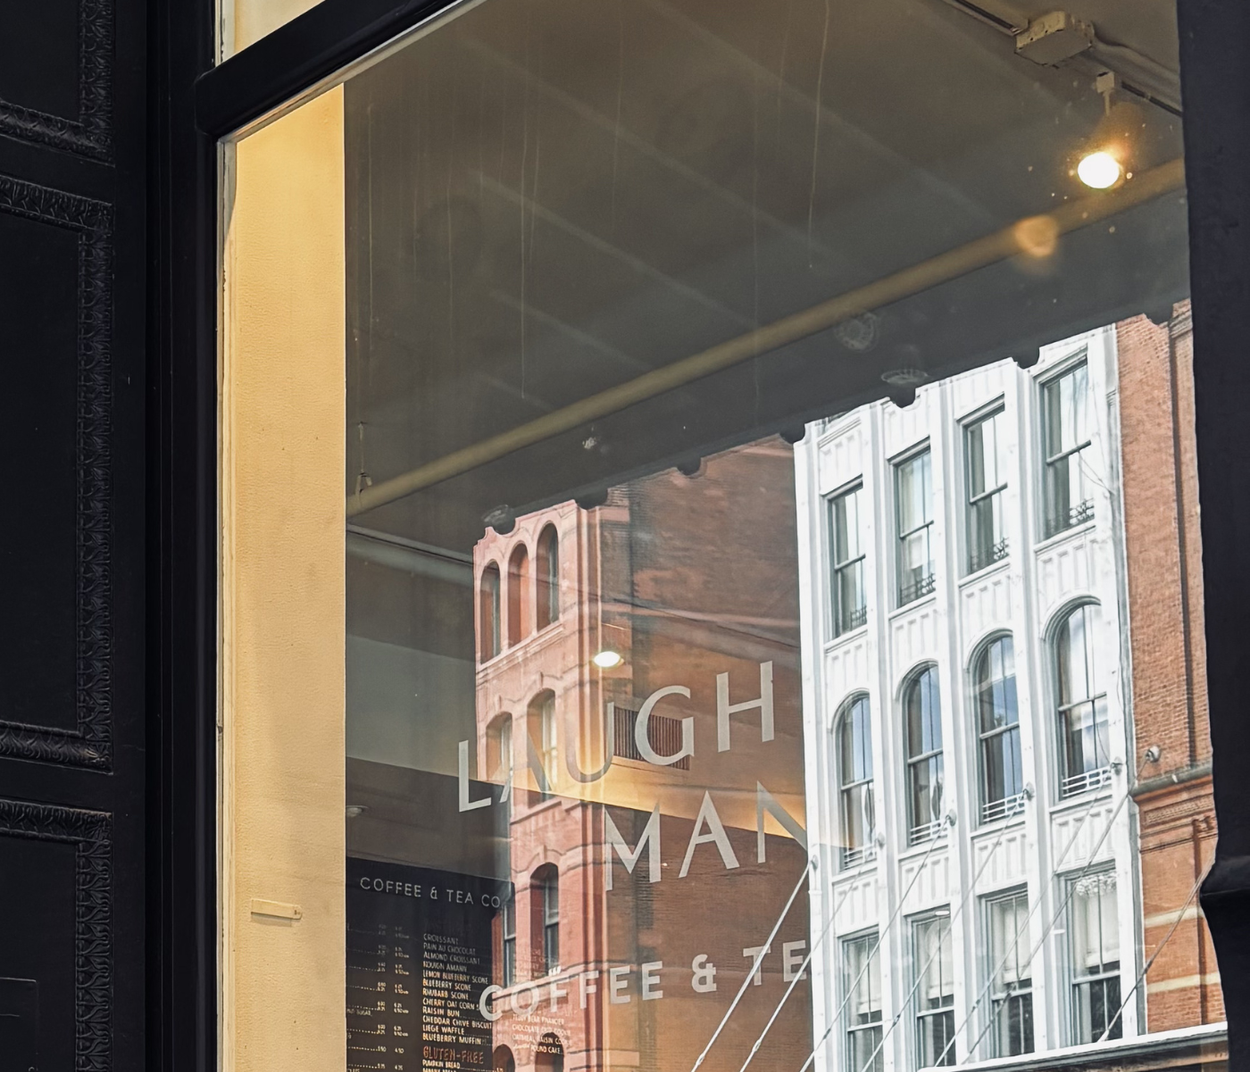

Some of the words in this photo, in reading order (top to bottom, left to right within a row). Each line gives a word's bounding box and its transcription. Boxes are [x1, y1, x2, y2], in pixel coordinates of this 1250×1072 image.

[360, 877, 421, 898] COFFEE
[430, 886, 438, 899] &
[446, 889, 474, 905] TEA
[423, 933, 459, 945] CROISSANT
[423, 952, 448, 960] ALMOND
[478, 961, 664, 1022] COFFEE
[691, 953, 717, 993] &
[423, 1006, 444, 1015] RAISIN
[423, 1015, 450, 1025] CHEDDAR
[453, 1019, 469, 1027] CHIVE
[472, 1021, 492, 1030] BISCUIT
[423, 1025, 439, 1033] LIEGE
[441, 1026, 465, 1036] WAFFLE
[423, 1032, 456, 1043] BLUEBERRY
